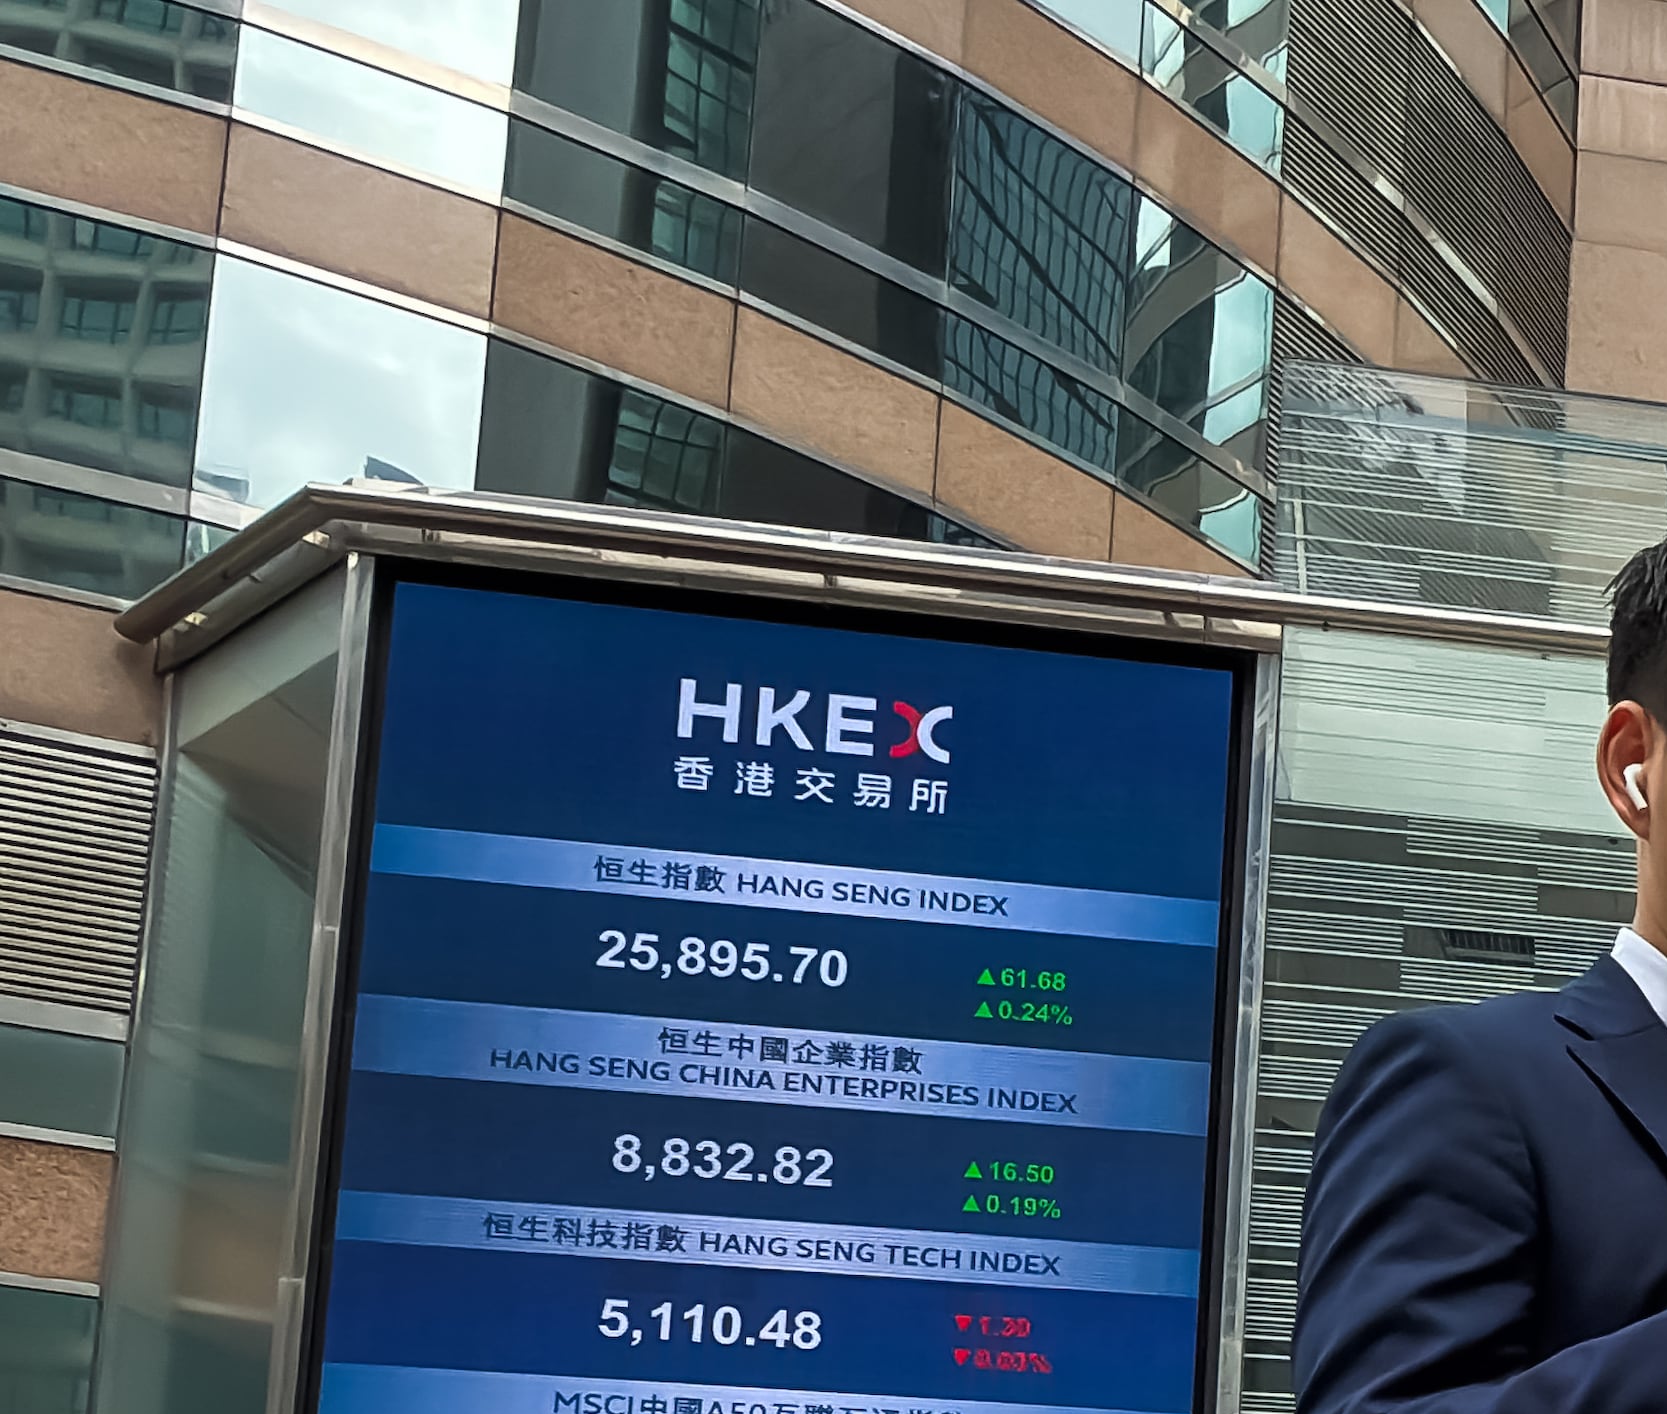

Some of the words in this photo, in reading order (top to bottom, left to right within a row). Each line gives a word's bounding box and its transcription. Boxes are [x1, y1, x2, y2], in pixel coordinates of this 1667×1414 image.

[678, 679, 953, 763] HKEX
[674, 757, 947, 814] 香港交易所
[592, 855, 726, 894] 恒生指數
[738, 873, 823, 898] HANG
[832, 882, 910, 907] SENG
[920, 890, 1008, 917] INDEX
[596, 930, 847, 986] 25,895.70
[1000, 967, 1066, 992] 61.68
[999, 1001, 1072, 1024] 0.24%
[658, 1026, 924, 1075] 恒生中國企業指數
[490, 1048, 579, 1073] HANG
[588, 1056, 670, 1081] SENG
[679, 1064, 776, 1090] CHINA
[783, 1072, 979, 1106] ENTERPRISES
[988, 1088, 1078, 1114] INDEX
[613, 1134, 833, 1186] 8,832.82
[989, 1161, 1054, 1184] 16.50
[987, 1195, 1060, 1218] 0.19%
[479, 1206, 690, 1252] 恒生科技指數
[700, 1231, 788, 1256] HANG
[795, 1236, 879, 1263] SENG
[884, 1245, 961, 1269] TECH
[970, 1251, 1062, 1276] INDEX
[599, 1299, 821, 1349] 5,110.48
